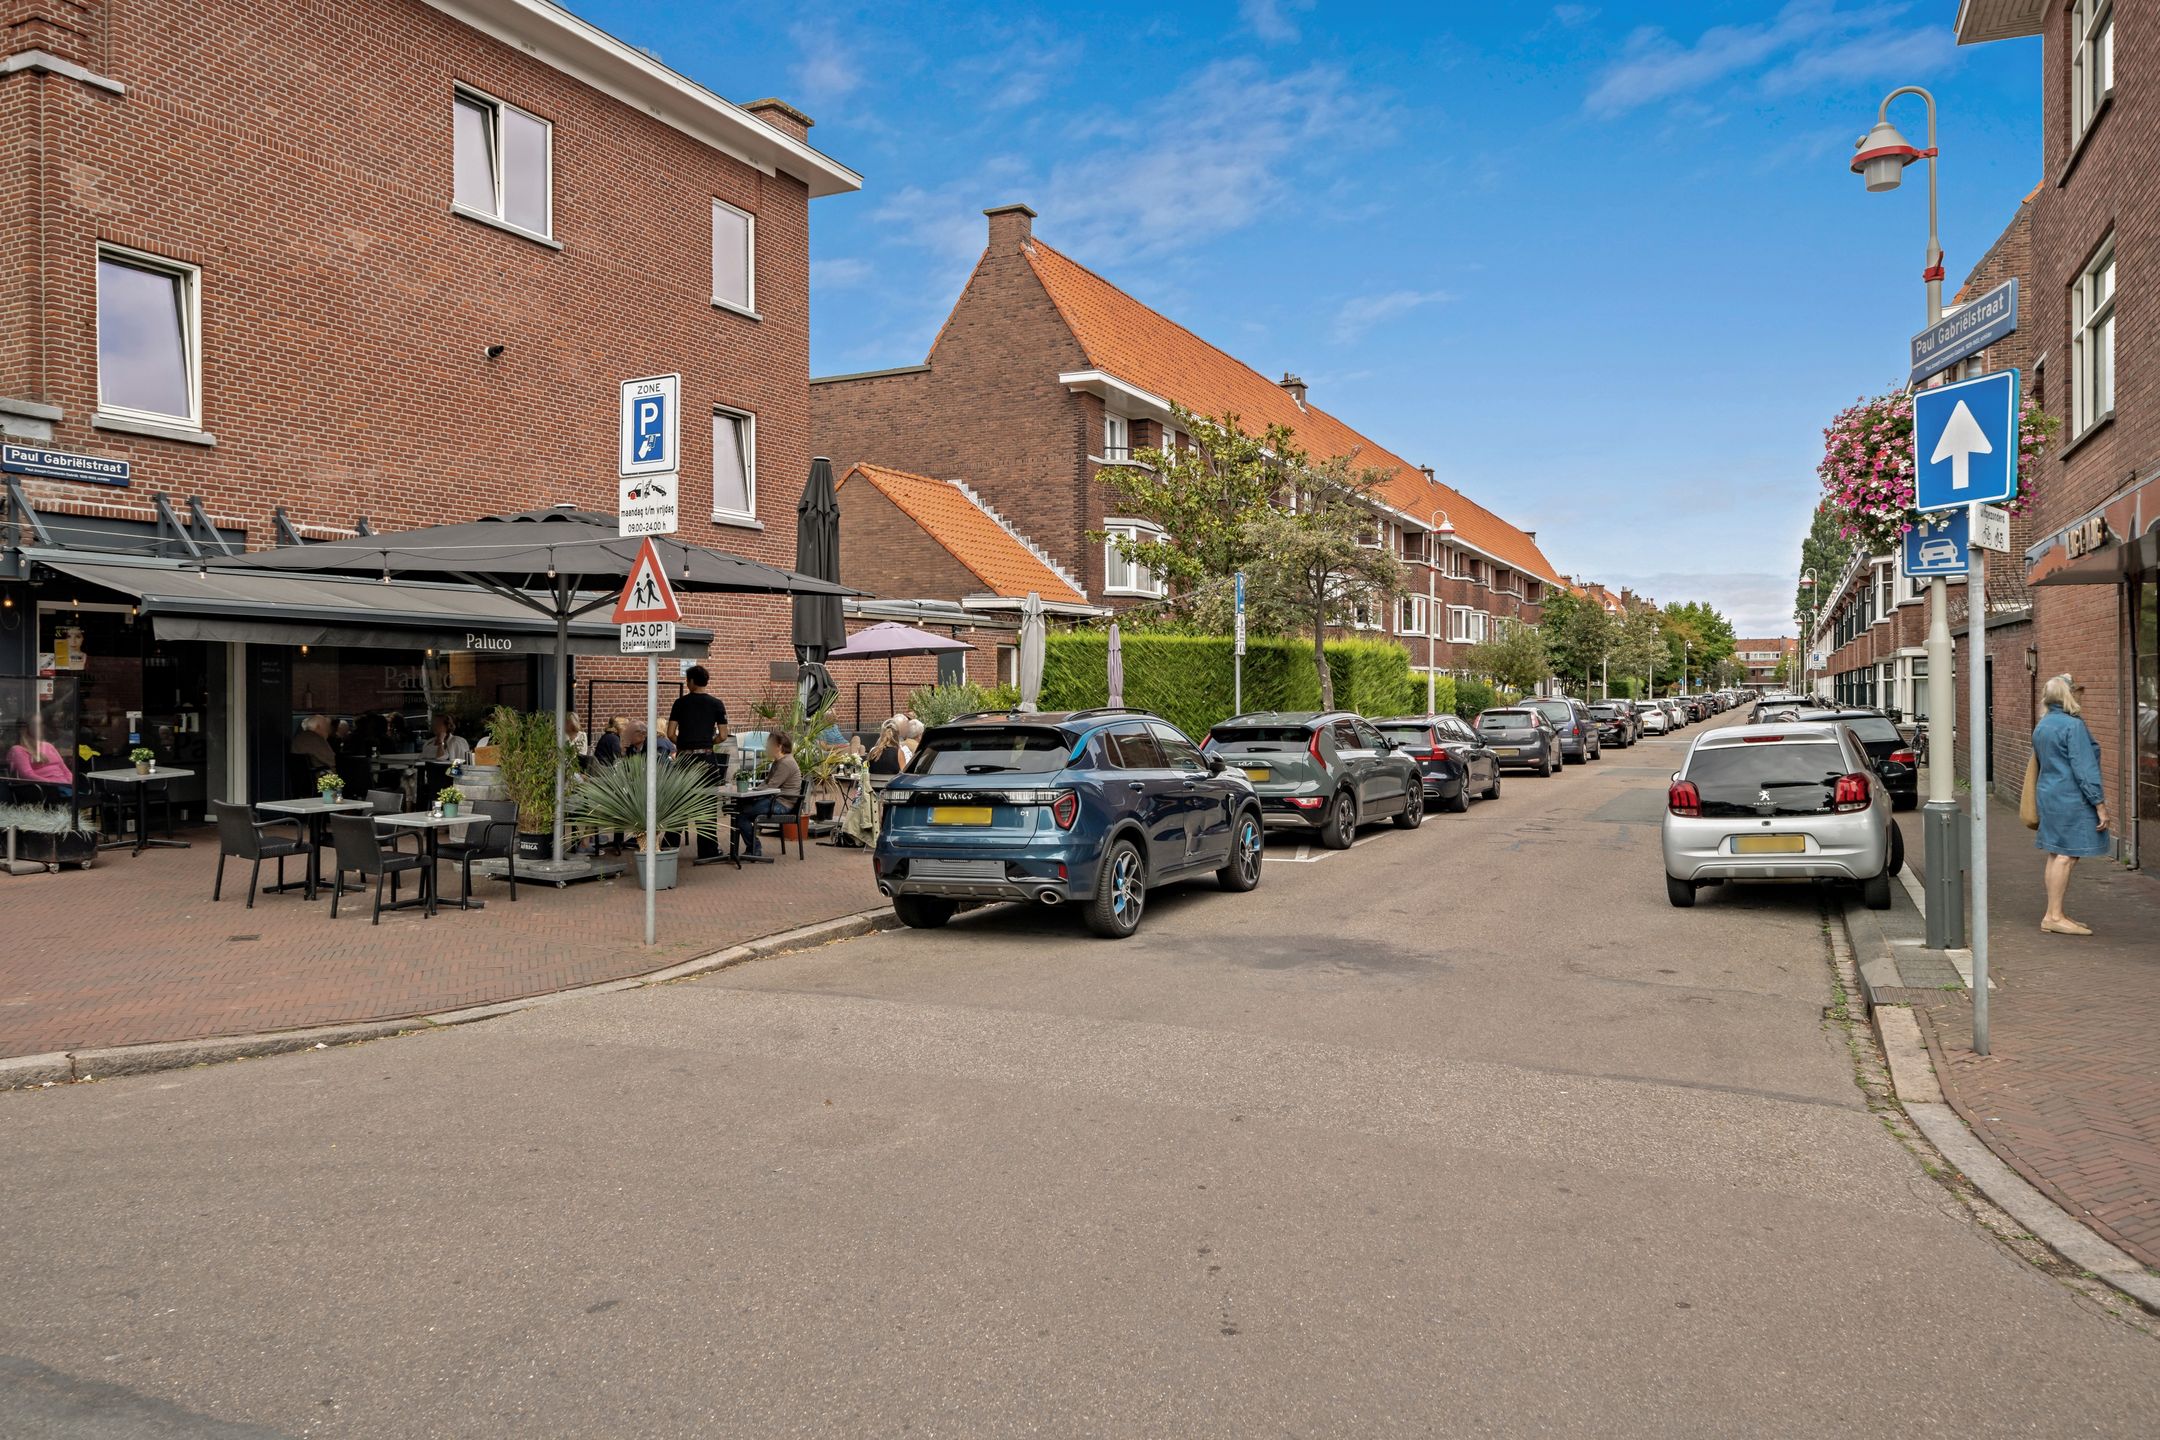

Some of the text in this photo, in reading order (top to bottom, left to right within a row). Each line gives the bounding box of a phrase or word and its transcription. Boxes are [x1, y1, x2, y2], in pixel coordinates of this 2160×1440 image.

[1916, 332, 1935, 358] Paul
[1938, 293, 2004, 345] Gabriëlstraat
[637, 383, 661, 395] ZONE
[640, 402, 659, 436] P
[11, 449, 122, 473] Paul Gabriëlstraat
[621, 504, 674, 518] maandag t/m vrijdag
[662, 521, 667, 531] h
[625, 624, 646, 637] PAS
[648, 623, 663, 637] OP
[466, 633, 512, 650] Paluco
[646, 638, 671, 649] kinderen
